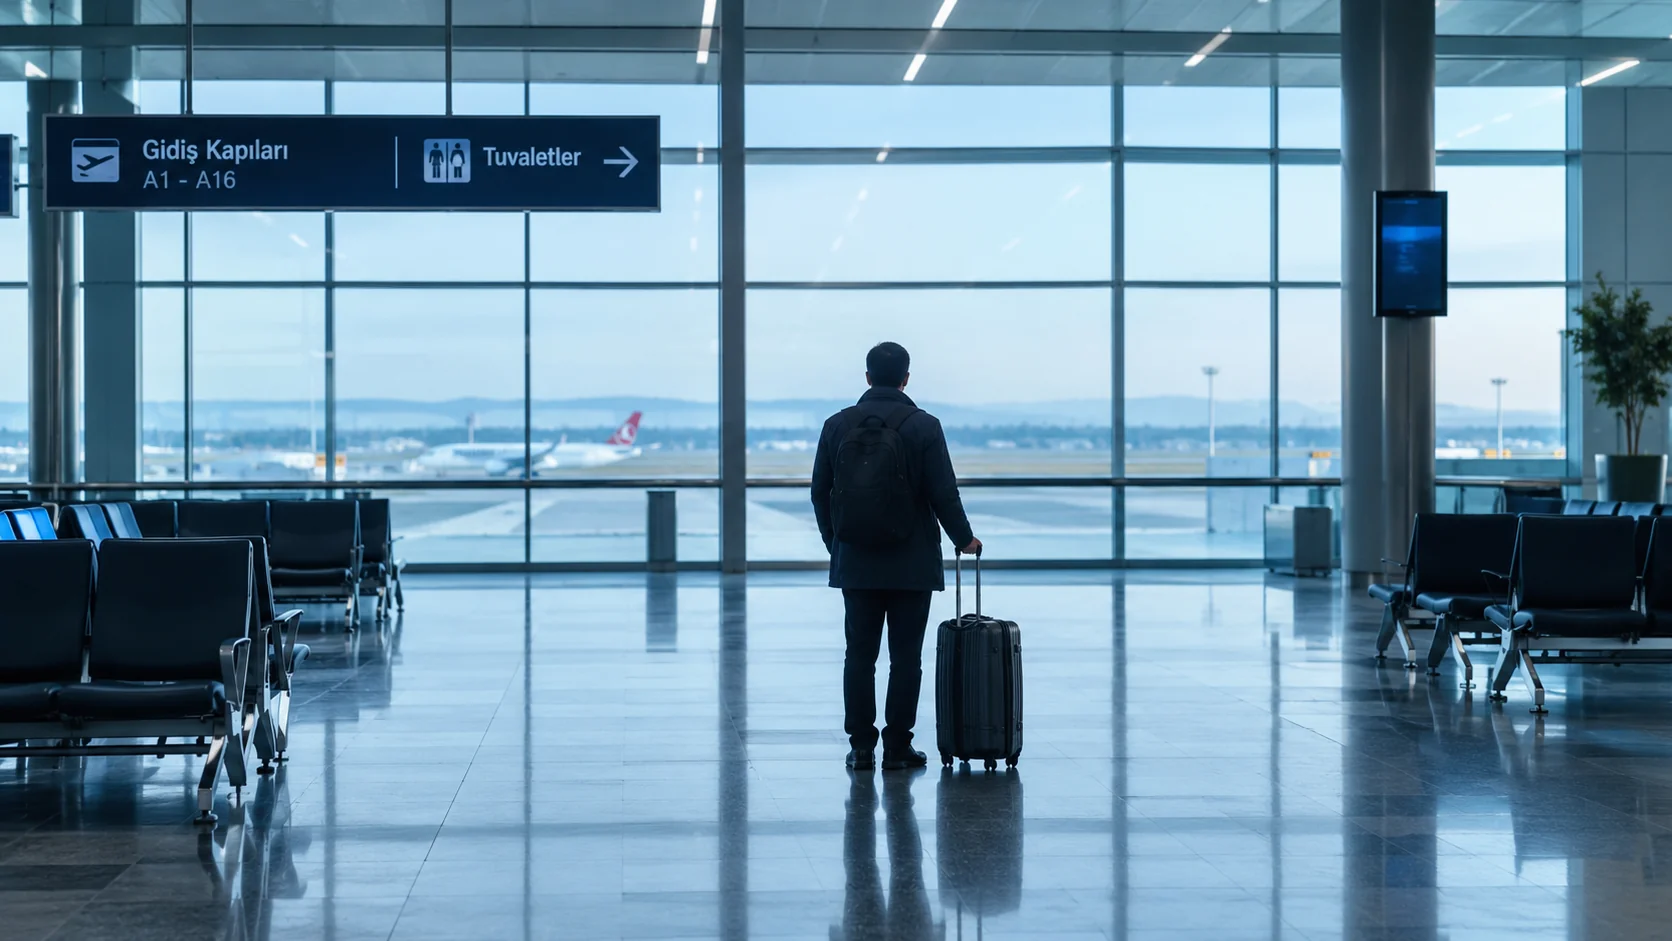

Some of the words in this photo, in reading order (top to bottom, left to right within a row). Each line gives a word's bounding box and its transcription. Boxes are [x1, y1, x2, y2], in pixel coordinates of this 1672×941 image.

[142, 138, 199, 165] Gidiş
[206, 138, 289, 165] Kapıları
[483, 146, 582, 167] Tuvaletler
[143, 170, 169, 189] A1
[195, 170, 237, 189] A16
